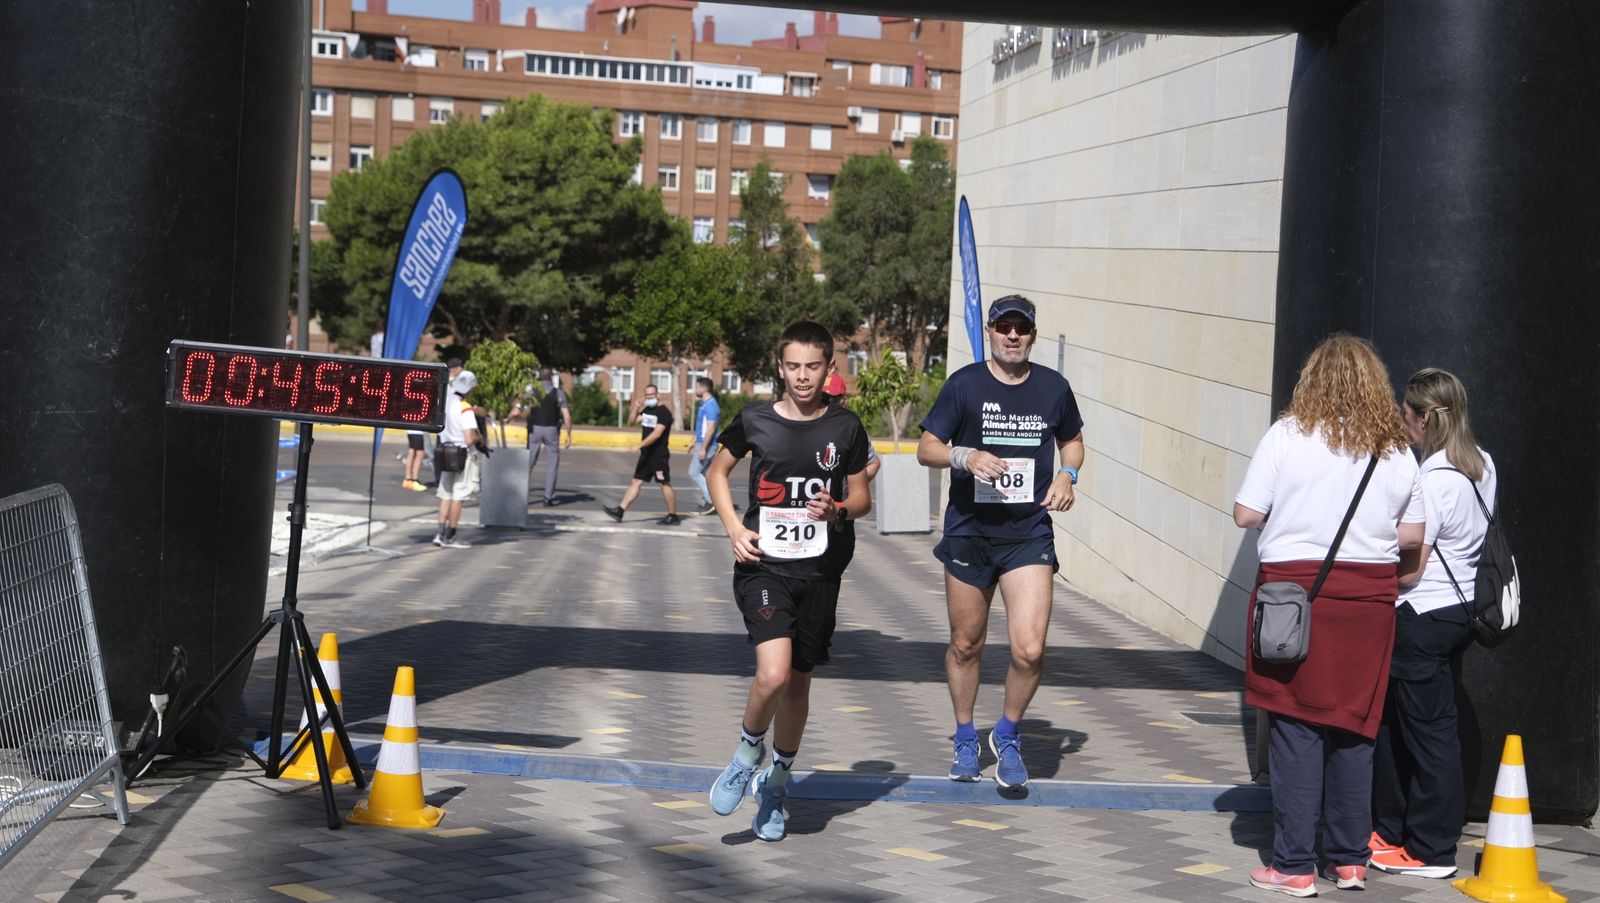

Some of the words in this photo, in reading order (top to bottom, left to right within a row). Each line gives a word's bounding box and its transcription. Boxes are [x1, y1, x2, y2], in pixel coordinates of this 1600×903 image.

[182, 351, 432, 421] 00:45:45
[982, 413, 1007, 421] Medio
[1009, 414, 1042, 422] Maratón
[982, 420, 1017, 430] Almería
[775, 524, 816, 541] 210
